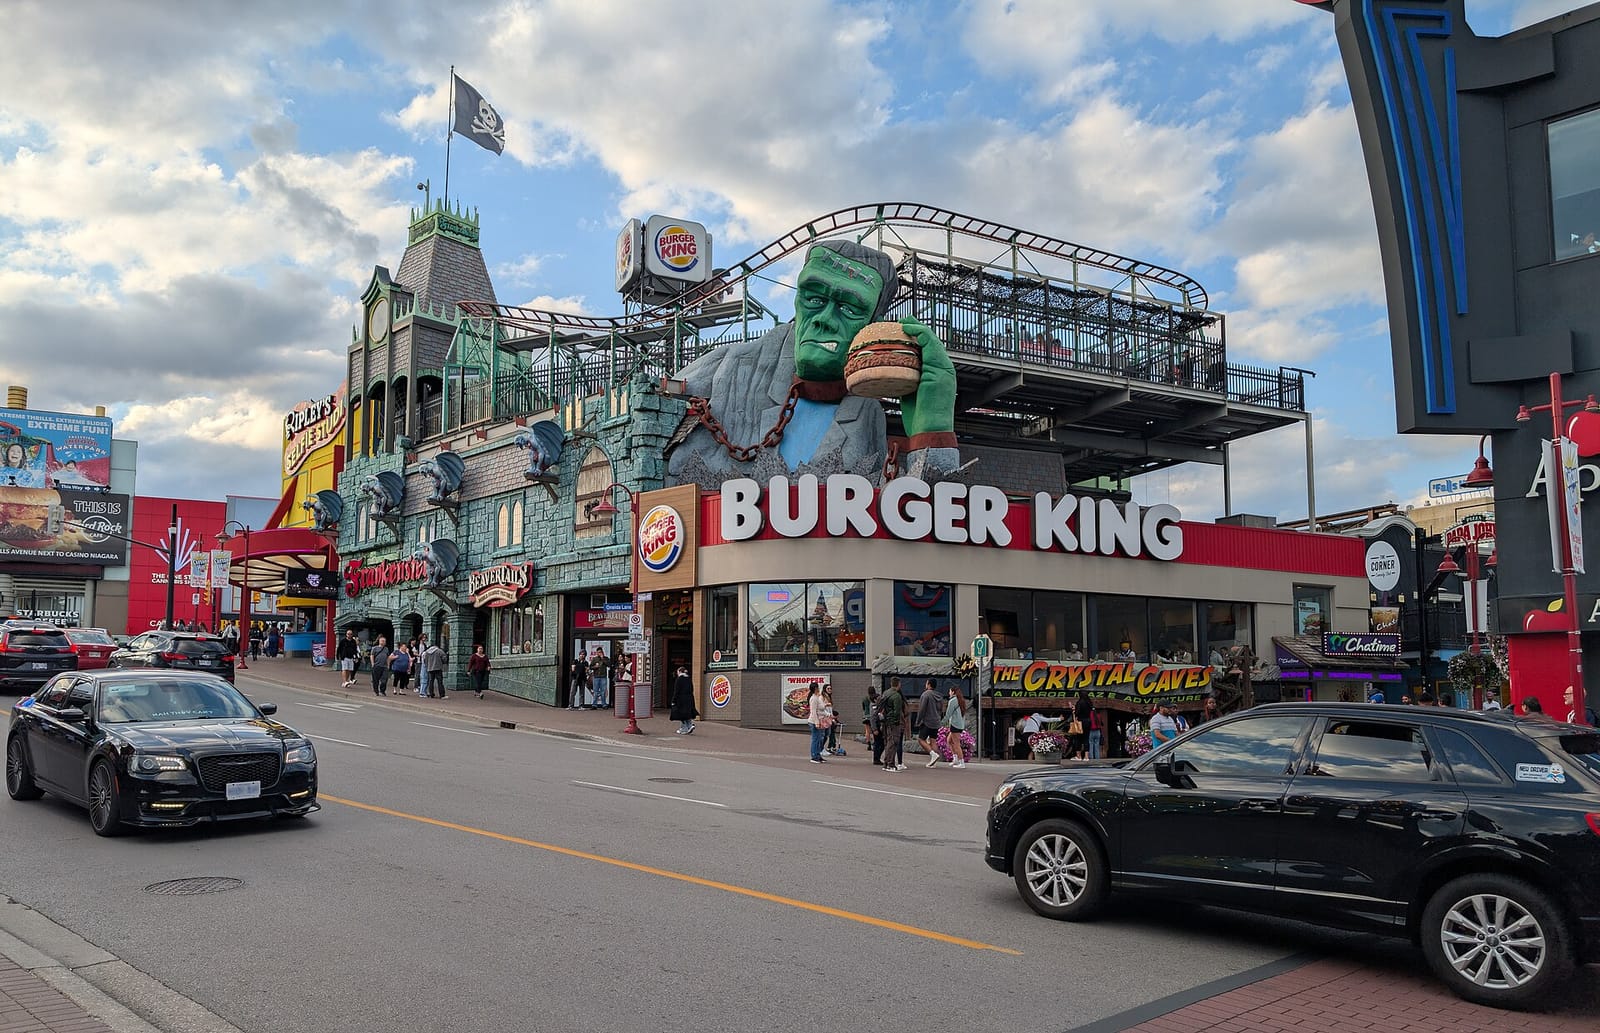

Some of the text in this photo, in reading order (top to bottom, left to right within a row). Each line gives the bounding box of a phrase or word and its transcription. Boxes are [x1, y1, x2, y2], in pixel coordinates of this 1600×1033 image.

[659, 234, 696, 246] BURGER
[661, 242, 697, 259] KING
[286, 395, 332, 440] RIPLEY'S
[28, 420, 109, 436] EXTREME FUN!
[286, 403, 343, 470] SELFIE STUDI
[1435, 479, 1458, 493] Falls
[73, 500, 121, 515] THIS IS
[720, 473, 1185, 562] BURGER KING
[97, 522, 122, 535] Rock
[1446, 522, 1497, 543] PAPA JOH
[643, 525, 676, 560] KING
[1370, 560, 1395, 572] CORNER
[1345, 637, 1397, 653] Chatime
[993, 660, 1215, 695] THE CRYSTAL CAVES
[713, 687, 729, 700] KING
[993, 690, 1003, 698] A
[1011, 690, 1066, 698] MIRROR
[1123, 694, 1201, 705] ADVETURE
